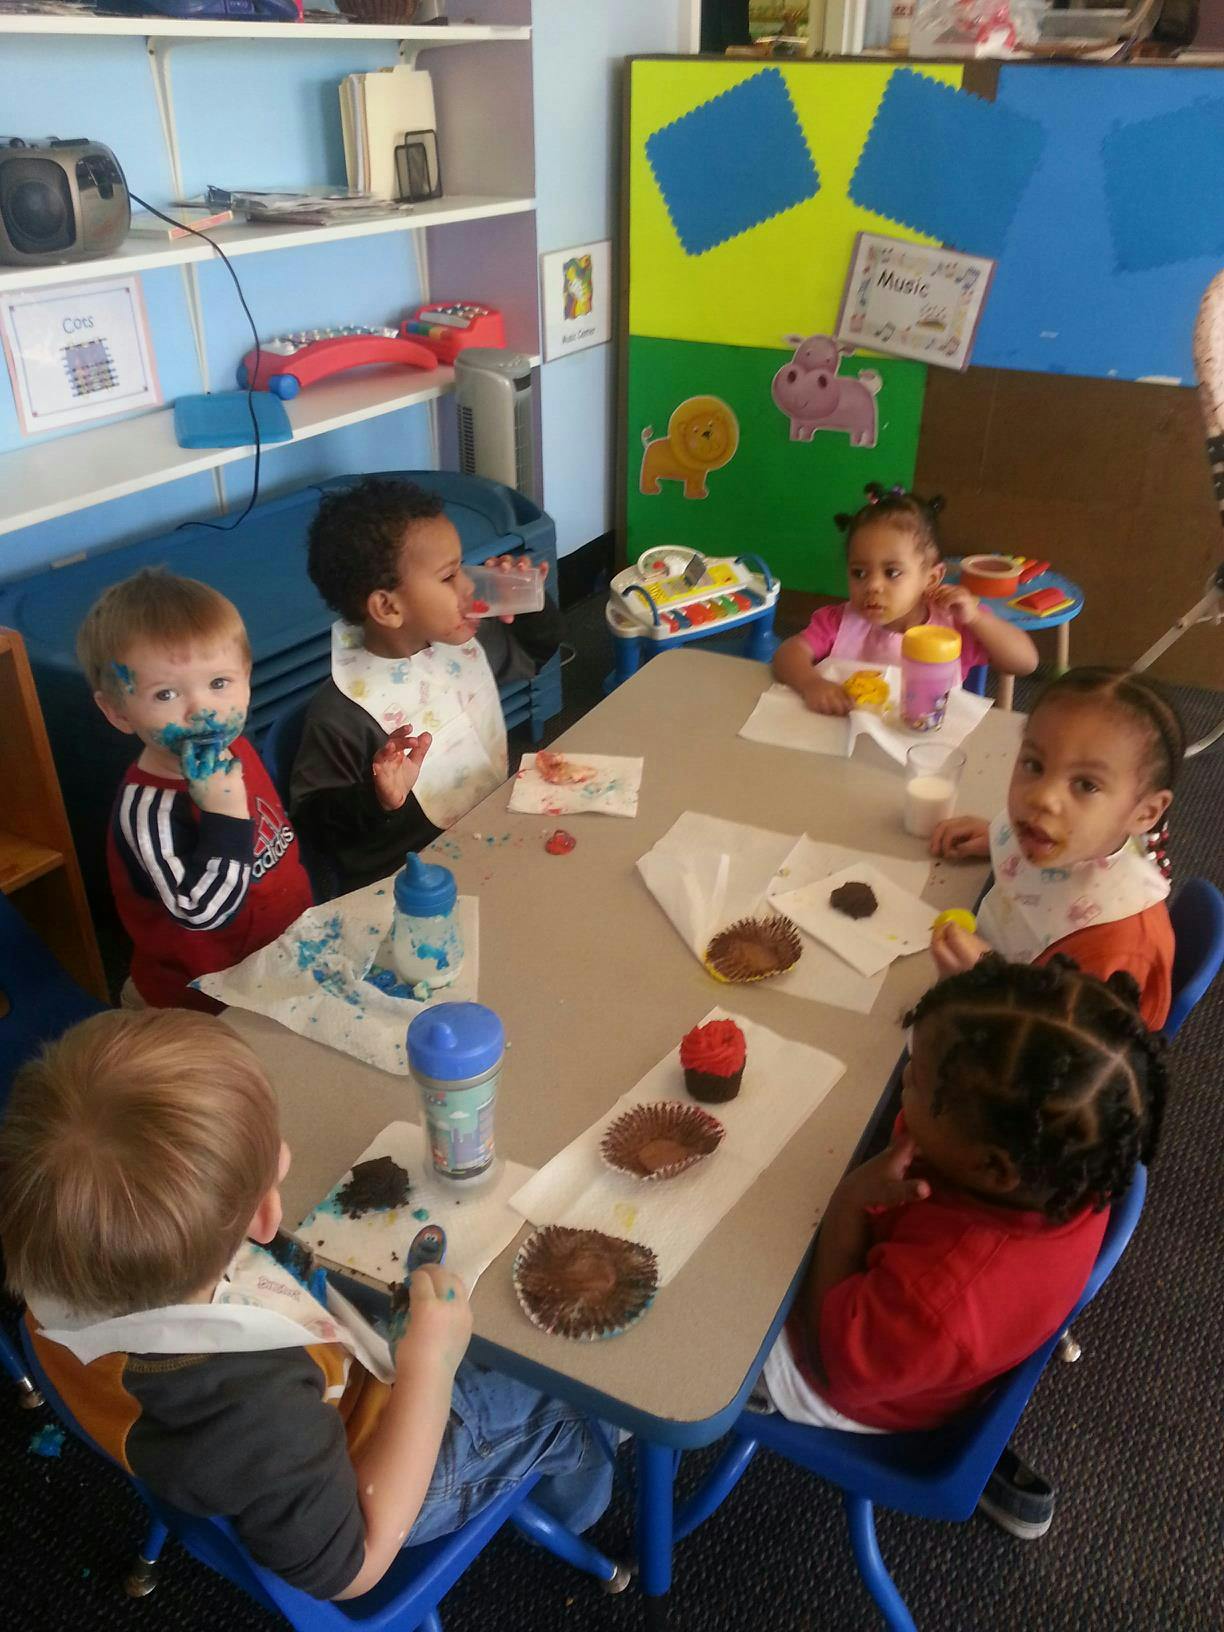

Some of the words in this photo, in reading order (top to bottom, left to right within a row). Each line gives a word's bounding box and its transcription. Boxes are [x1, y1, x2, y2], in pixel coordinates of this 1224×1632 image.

[876, 267, 929, 298] Music
[62, 315, 95, 334] Cots
[252, 826, 294, 878] adidas
